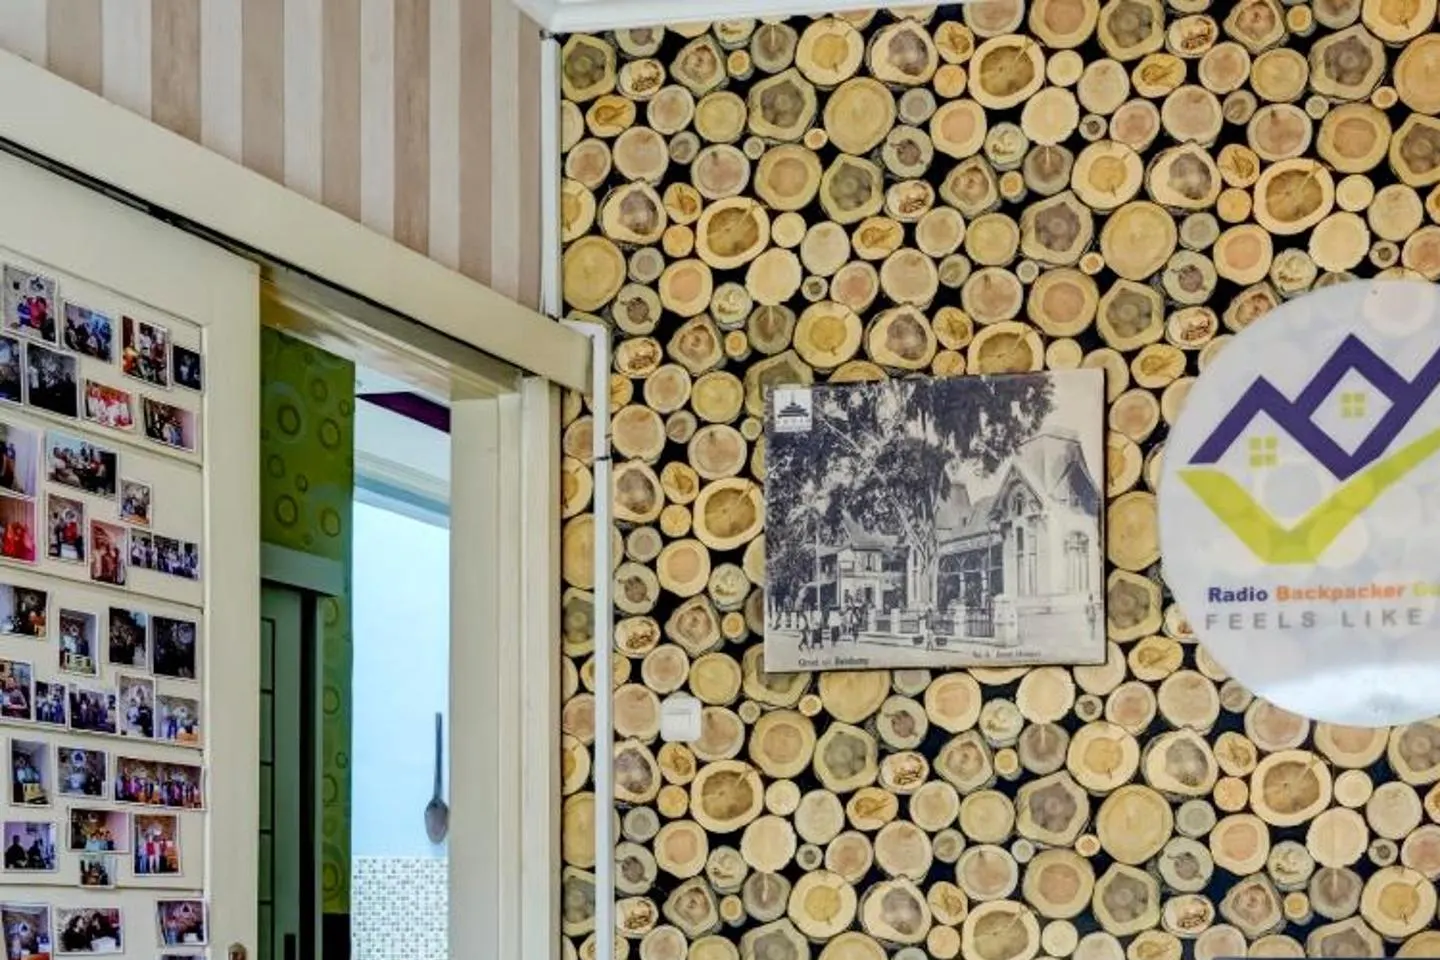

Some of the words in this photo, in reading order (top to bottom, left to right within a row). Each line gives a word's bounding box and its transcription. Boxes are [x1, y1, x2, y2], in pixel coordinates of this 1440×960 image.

[1207, 585, 1269, 603] Radio
[1275, 582, 1406, 602] Backpacker
[1205, 610, 1318, 631] FEELS
[1341, 607, 1424, 629] LIKE
